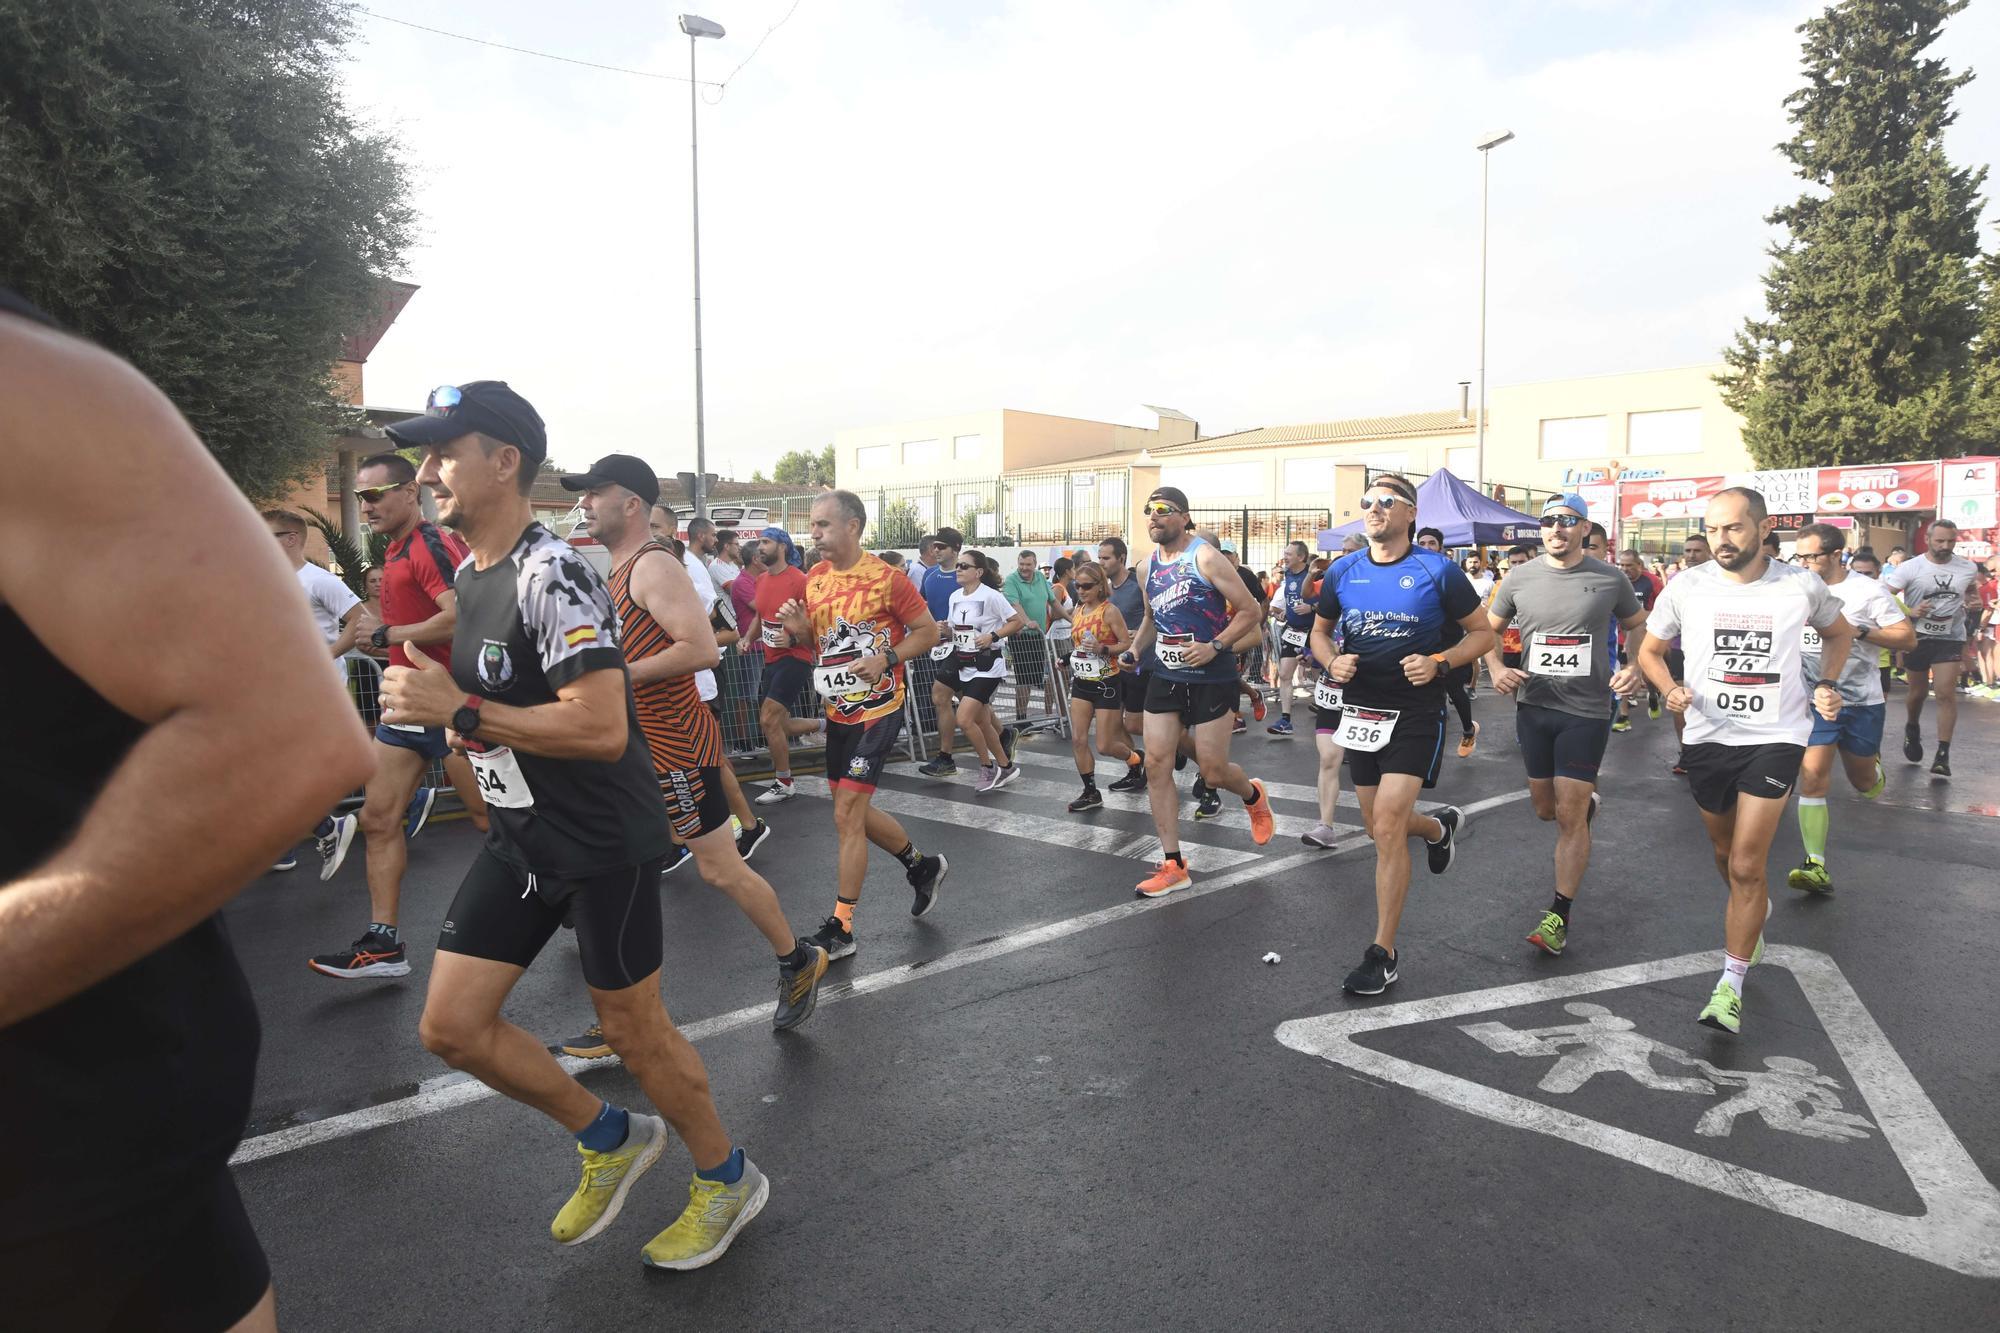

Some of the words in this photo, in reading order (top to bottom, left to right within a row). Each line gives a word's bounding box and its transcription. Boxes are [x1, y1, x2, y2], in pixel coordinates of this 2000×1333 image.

[1769, 491, 1810, 503] UER
[1777, 502, 1810, 512] AS
[1364, 610, 1384, 621] Club
[1385, 611, 1419, 622] Ciclista
[1924, 623, 1946, 631] 095
[1287, 633, 1302, 642] 255
[1162, 650, 1185, 663] 268
[1540, 652, 1579, 667] 244
[1074, 662, 1092, 672] 613
[823, 671, 857, 688] 145
[1318, 689, 1338, 705] 318
[1716, 692, 1764, 713] 050
[1346, 726, 1381, 743] 536
[475, 765, 507, 794] 54
